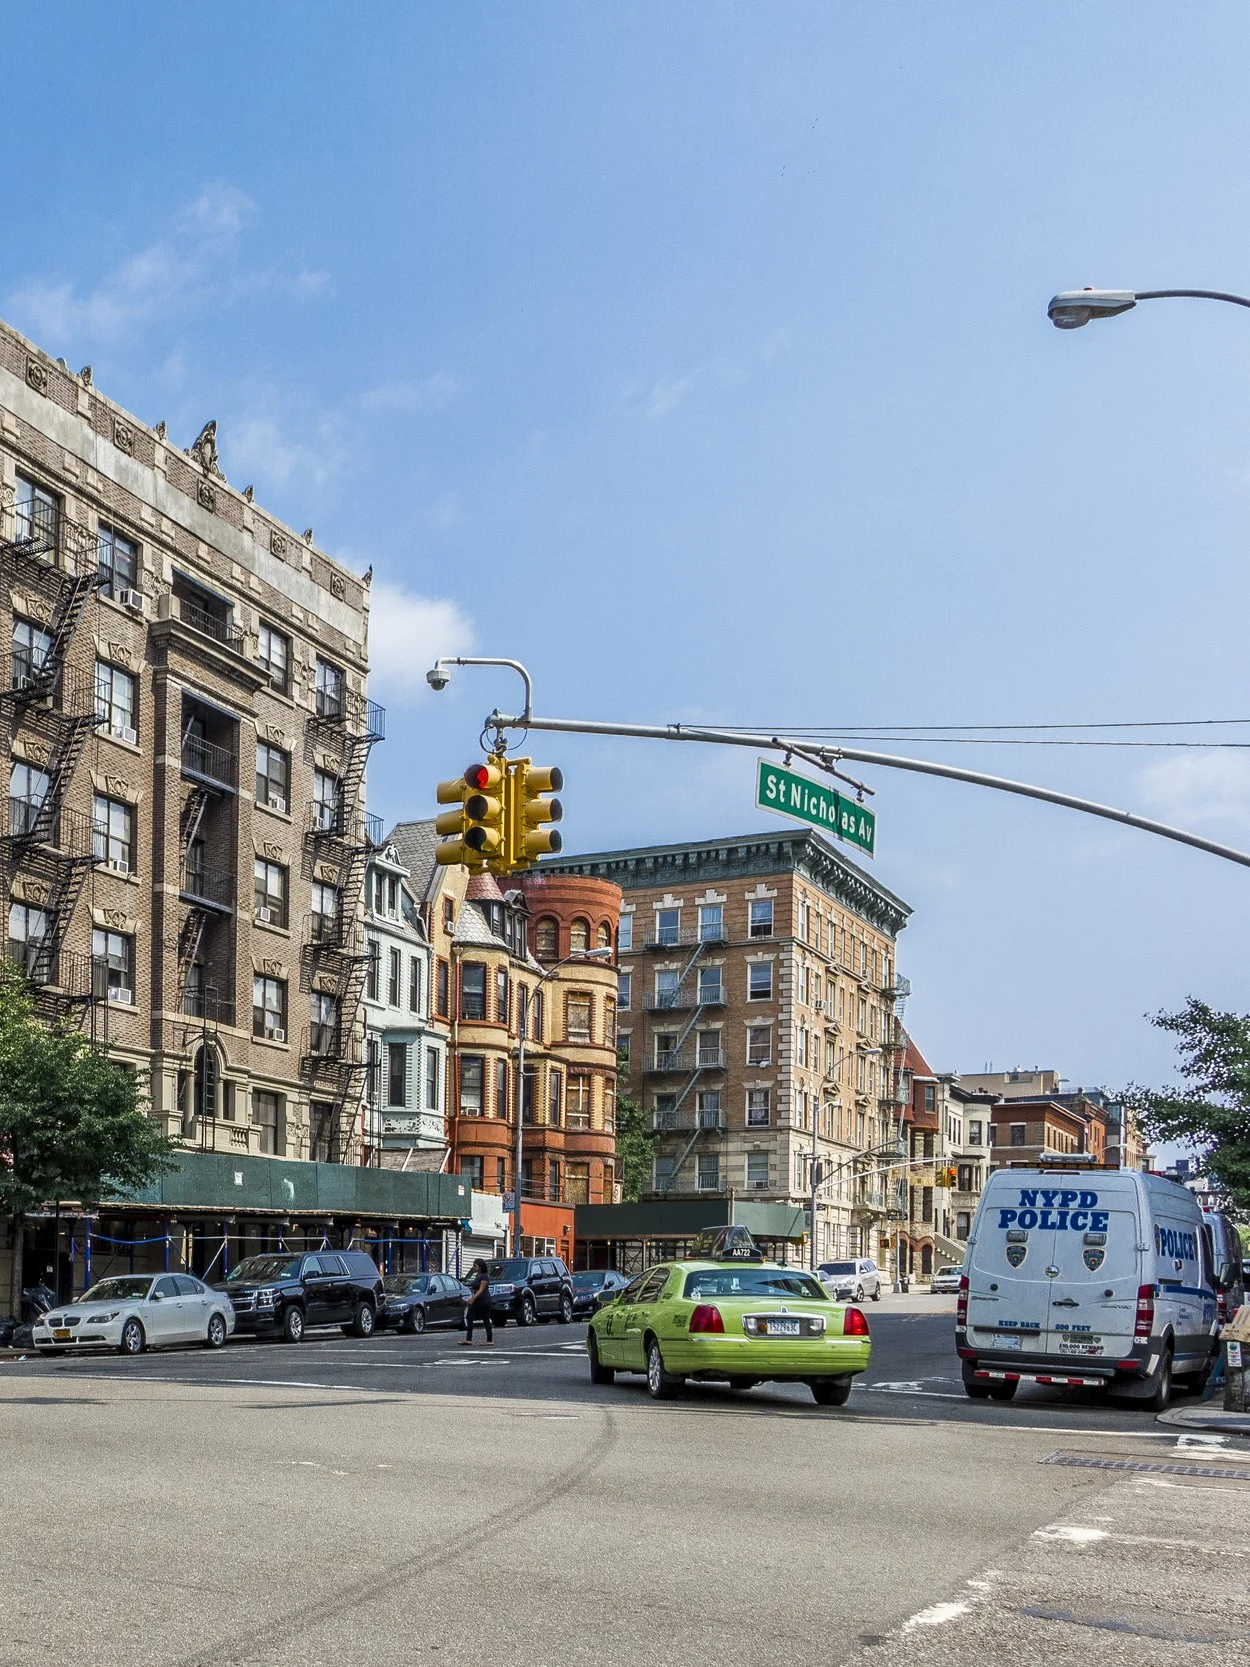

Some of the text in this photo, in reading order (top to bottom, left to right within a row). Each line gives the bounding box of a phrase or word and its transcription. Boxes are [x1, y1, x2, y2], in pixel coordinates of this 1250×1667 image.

[766, 775, 872, 842] St Nicholas Av
[1019, 1189, 1098, 1208] NYPD
[998, 1209, 1109, 1232] POLICE
[732, 1249, 750, 1257] AA722
[1160, 1228, 1195, 1260] POLICE
[1020, 1321, 1040, 1329] BACK
[1071, 1324, 1091, 1332] FEET
